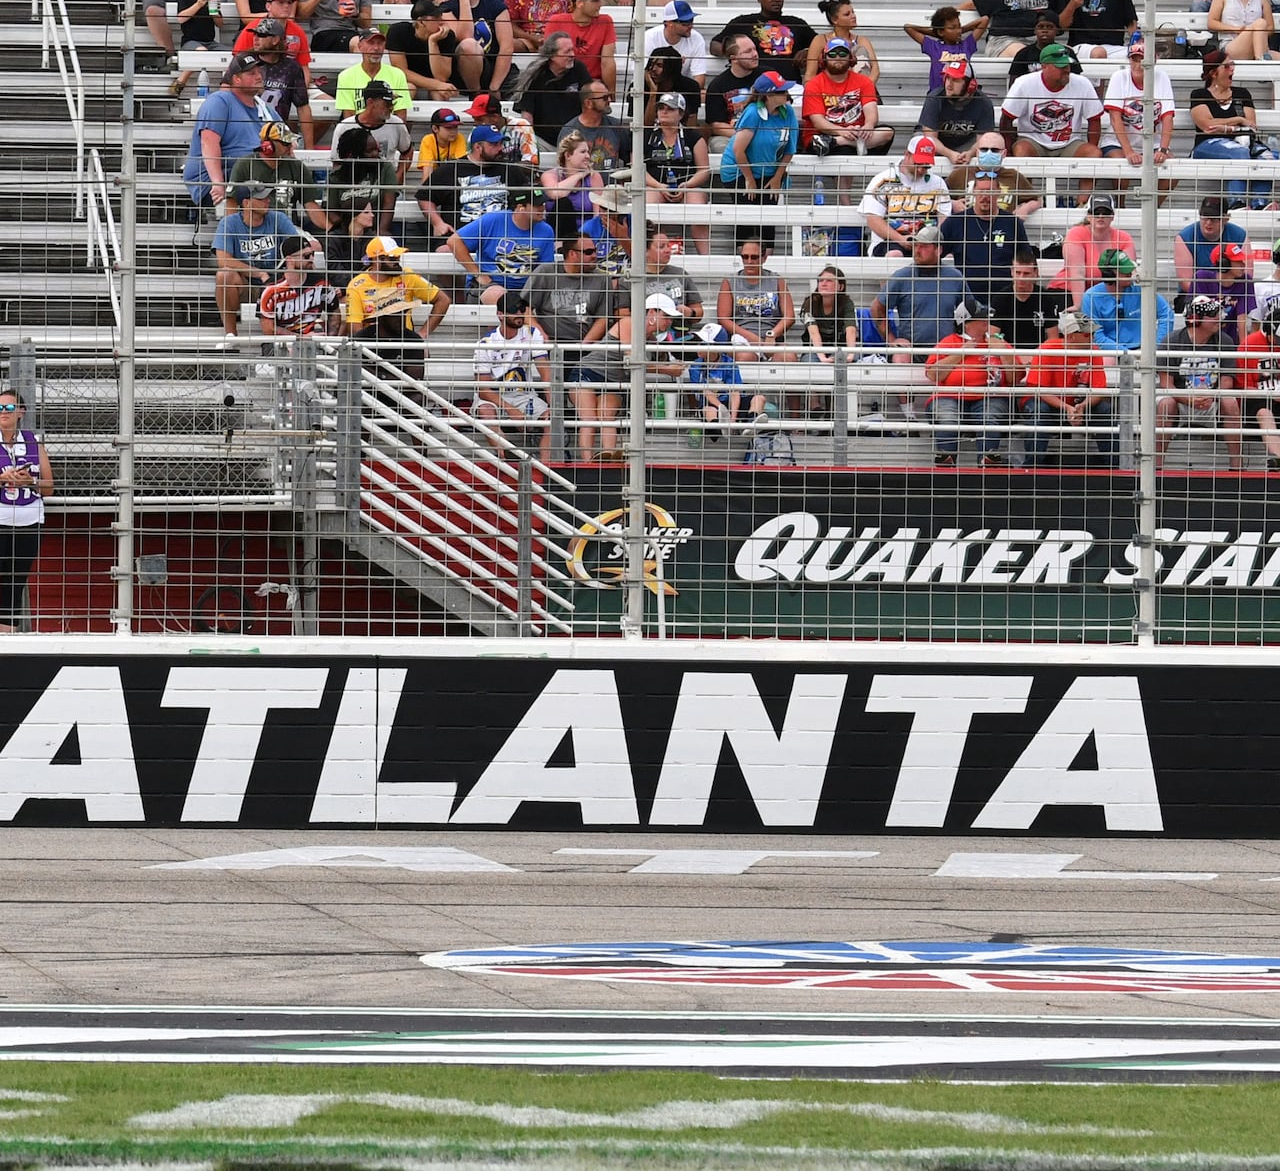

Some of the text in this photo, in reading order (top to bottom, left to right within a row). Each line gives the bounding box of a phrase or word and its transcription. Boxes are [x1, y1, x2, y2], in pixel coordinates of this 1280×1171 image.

[887, 193, 936, 214] BUS
[239, 235, 276, 253] BUSCH
[575, 302, 587, 315] 18
[735, 511, 1095, 586] QUAKER
